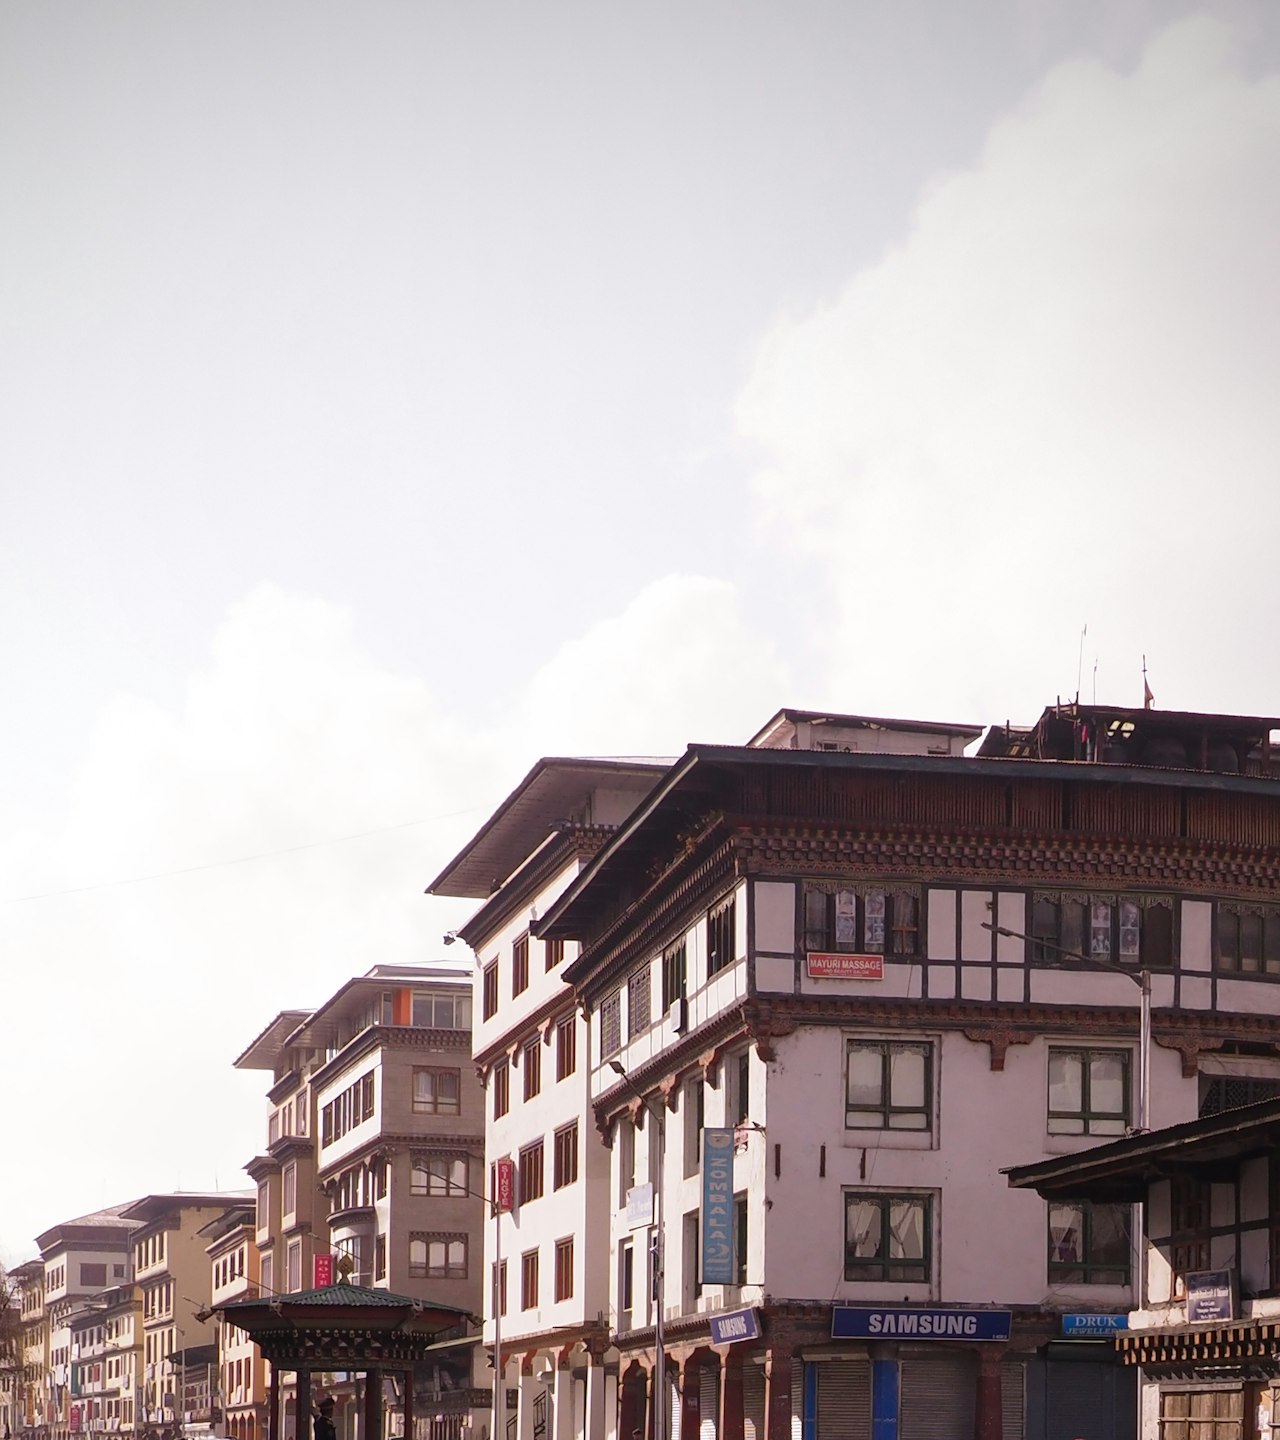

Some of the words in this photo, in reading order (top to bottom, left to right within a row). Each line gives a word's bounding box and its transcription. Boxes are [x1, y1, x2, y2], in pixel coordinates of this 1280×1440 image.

[810, 958, 840, 969] MAYURI
[842, 960, 881, 970] MASSAGE
[708, 1157, 728, 1240] ZOMBALA
[706, 1243, 730, 1264] 2
[717, 1315, 747, 1339] SAMSUNG
[868, 1313, 977, 1335] SAMSUNG
[1075, 1316, 1118, 1327] DRUK
